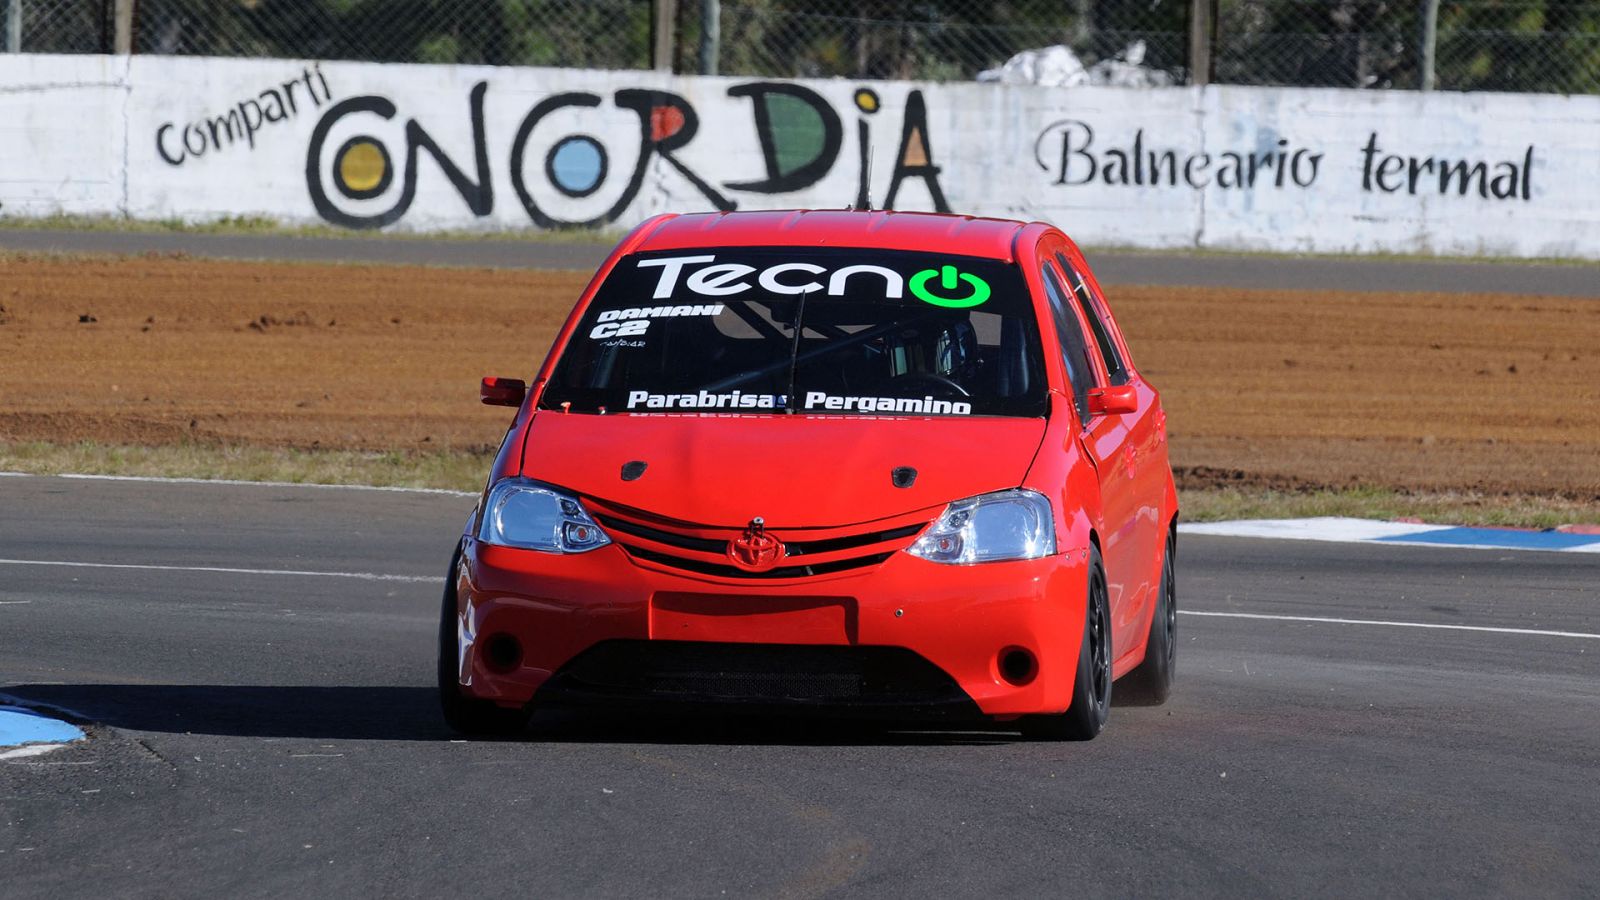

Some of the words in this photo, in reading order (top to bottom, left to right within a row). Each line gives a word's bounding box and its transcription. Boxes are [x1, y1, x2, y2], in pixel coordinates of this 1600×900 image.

[1035, 119, 1324, 189] Balneario
[1361, 131, 1535, 202] termal
[589, 320, 651, 339] C2
[804, 391, 972, 415] Pergamino
